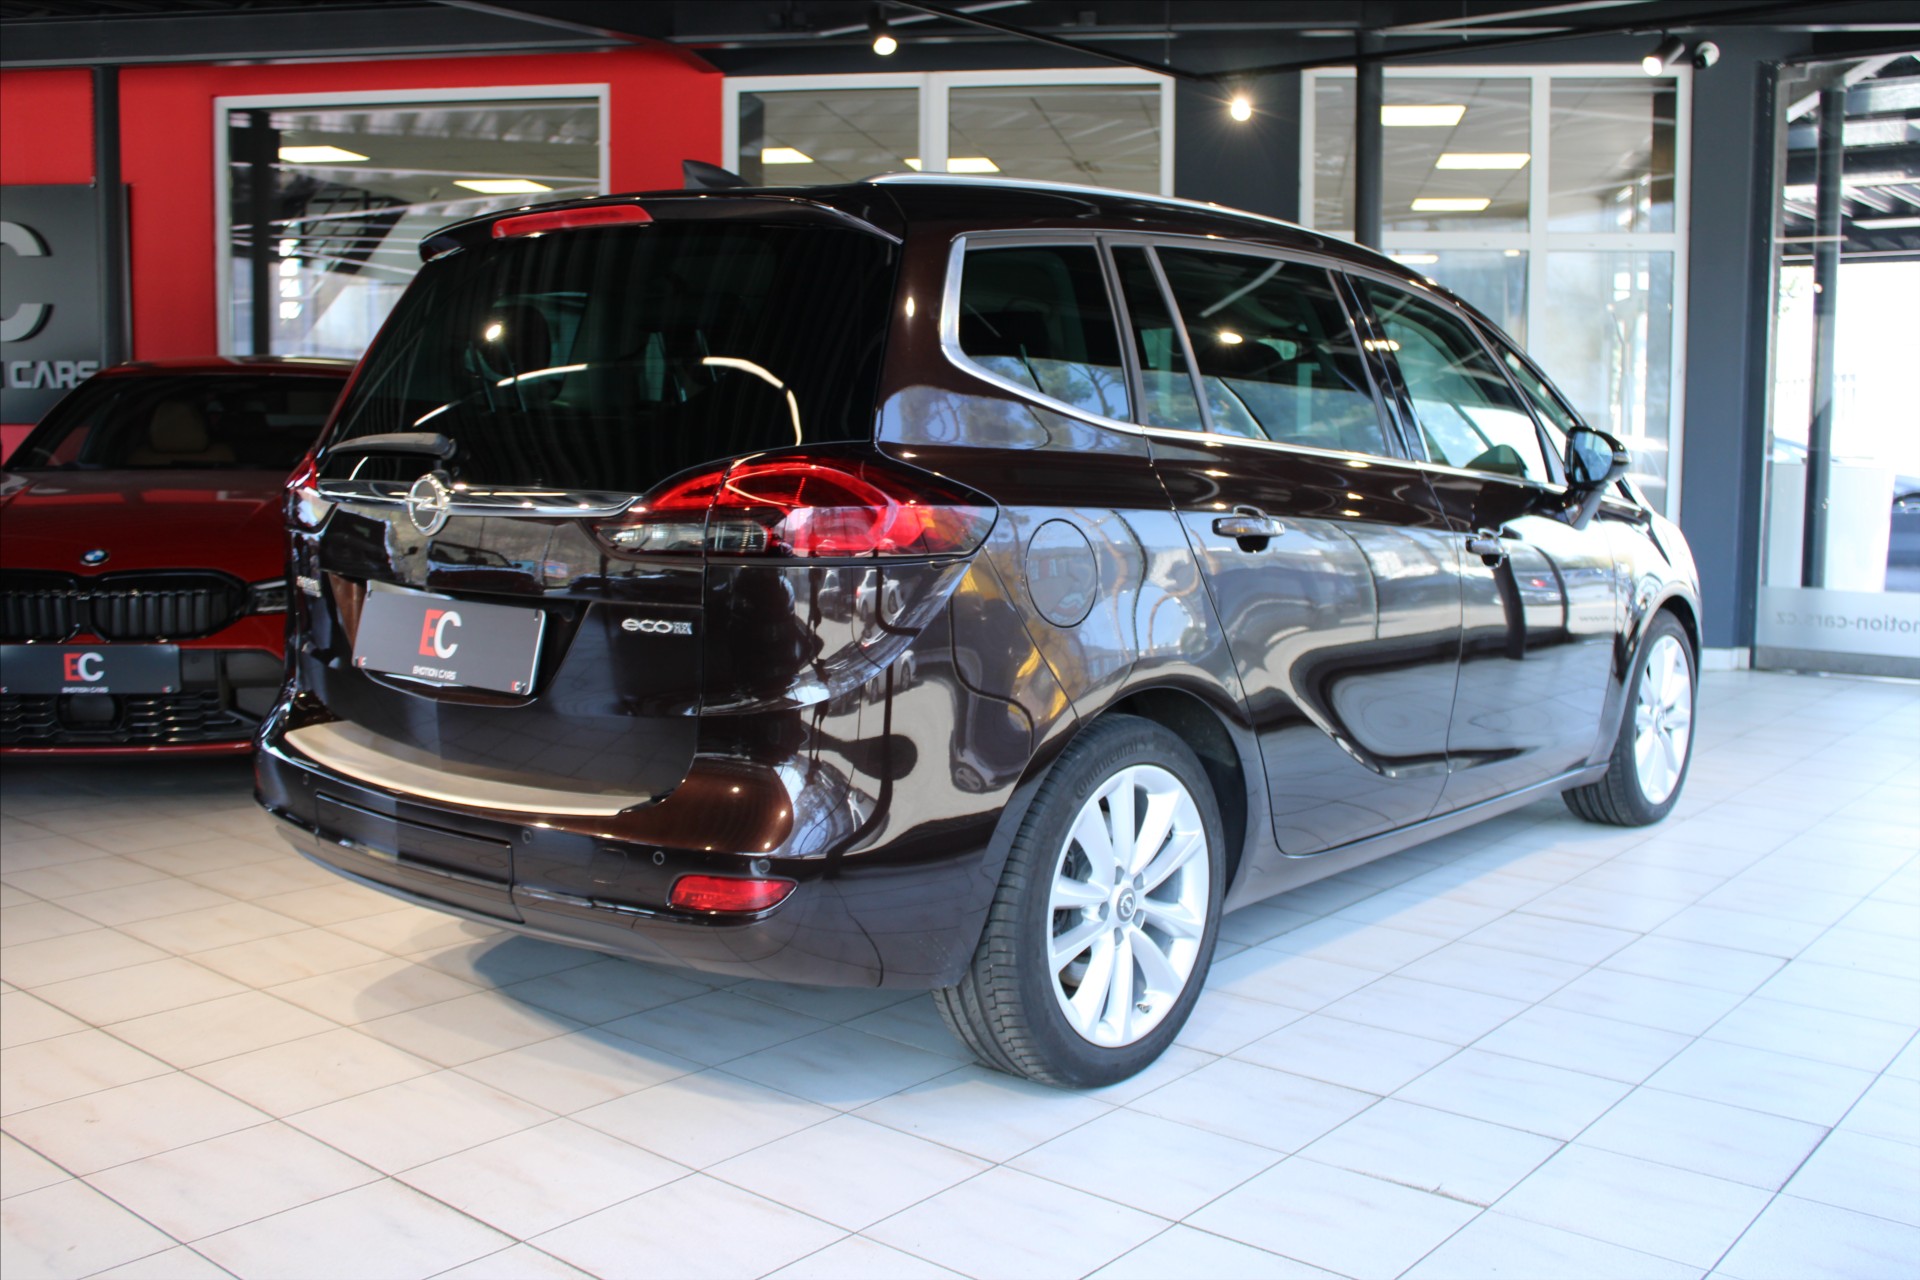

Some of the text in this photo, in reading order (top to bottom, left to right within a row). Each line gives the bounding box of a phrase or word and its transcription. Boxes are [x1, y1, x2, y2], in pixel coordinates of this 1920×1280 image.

[9, 361, 99, 389] CARS
[418, 609, 462, 659] EC
[63, 652, 105, 682] EC
